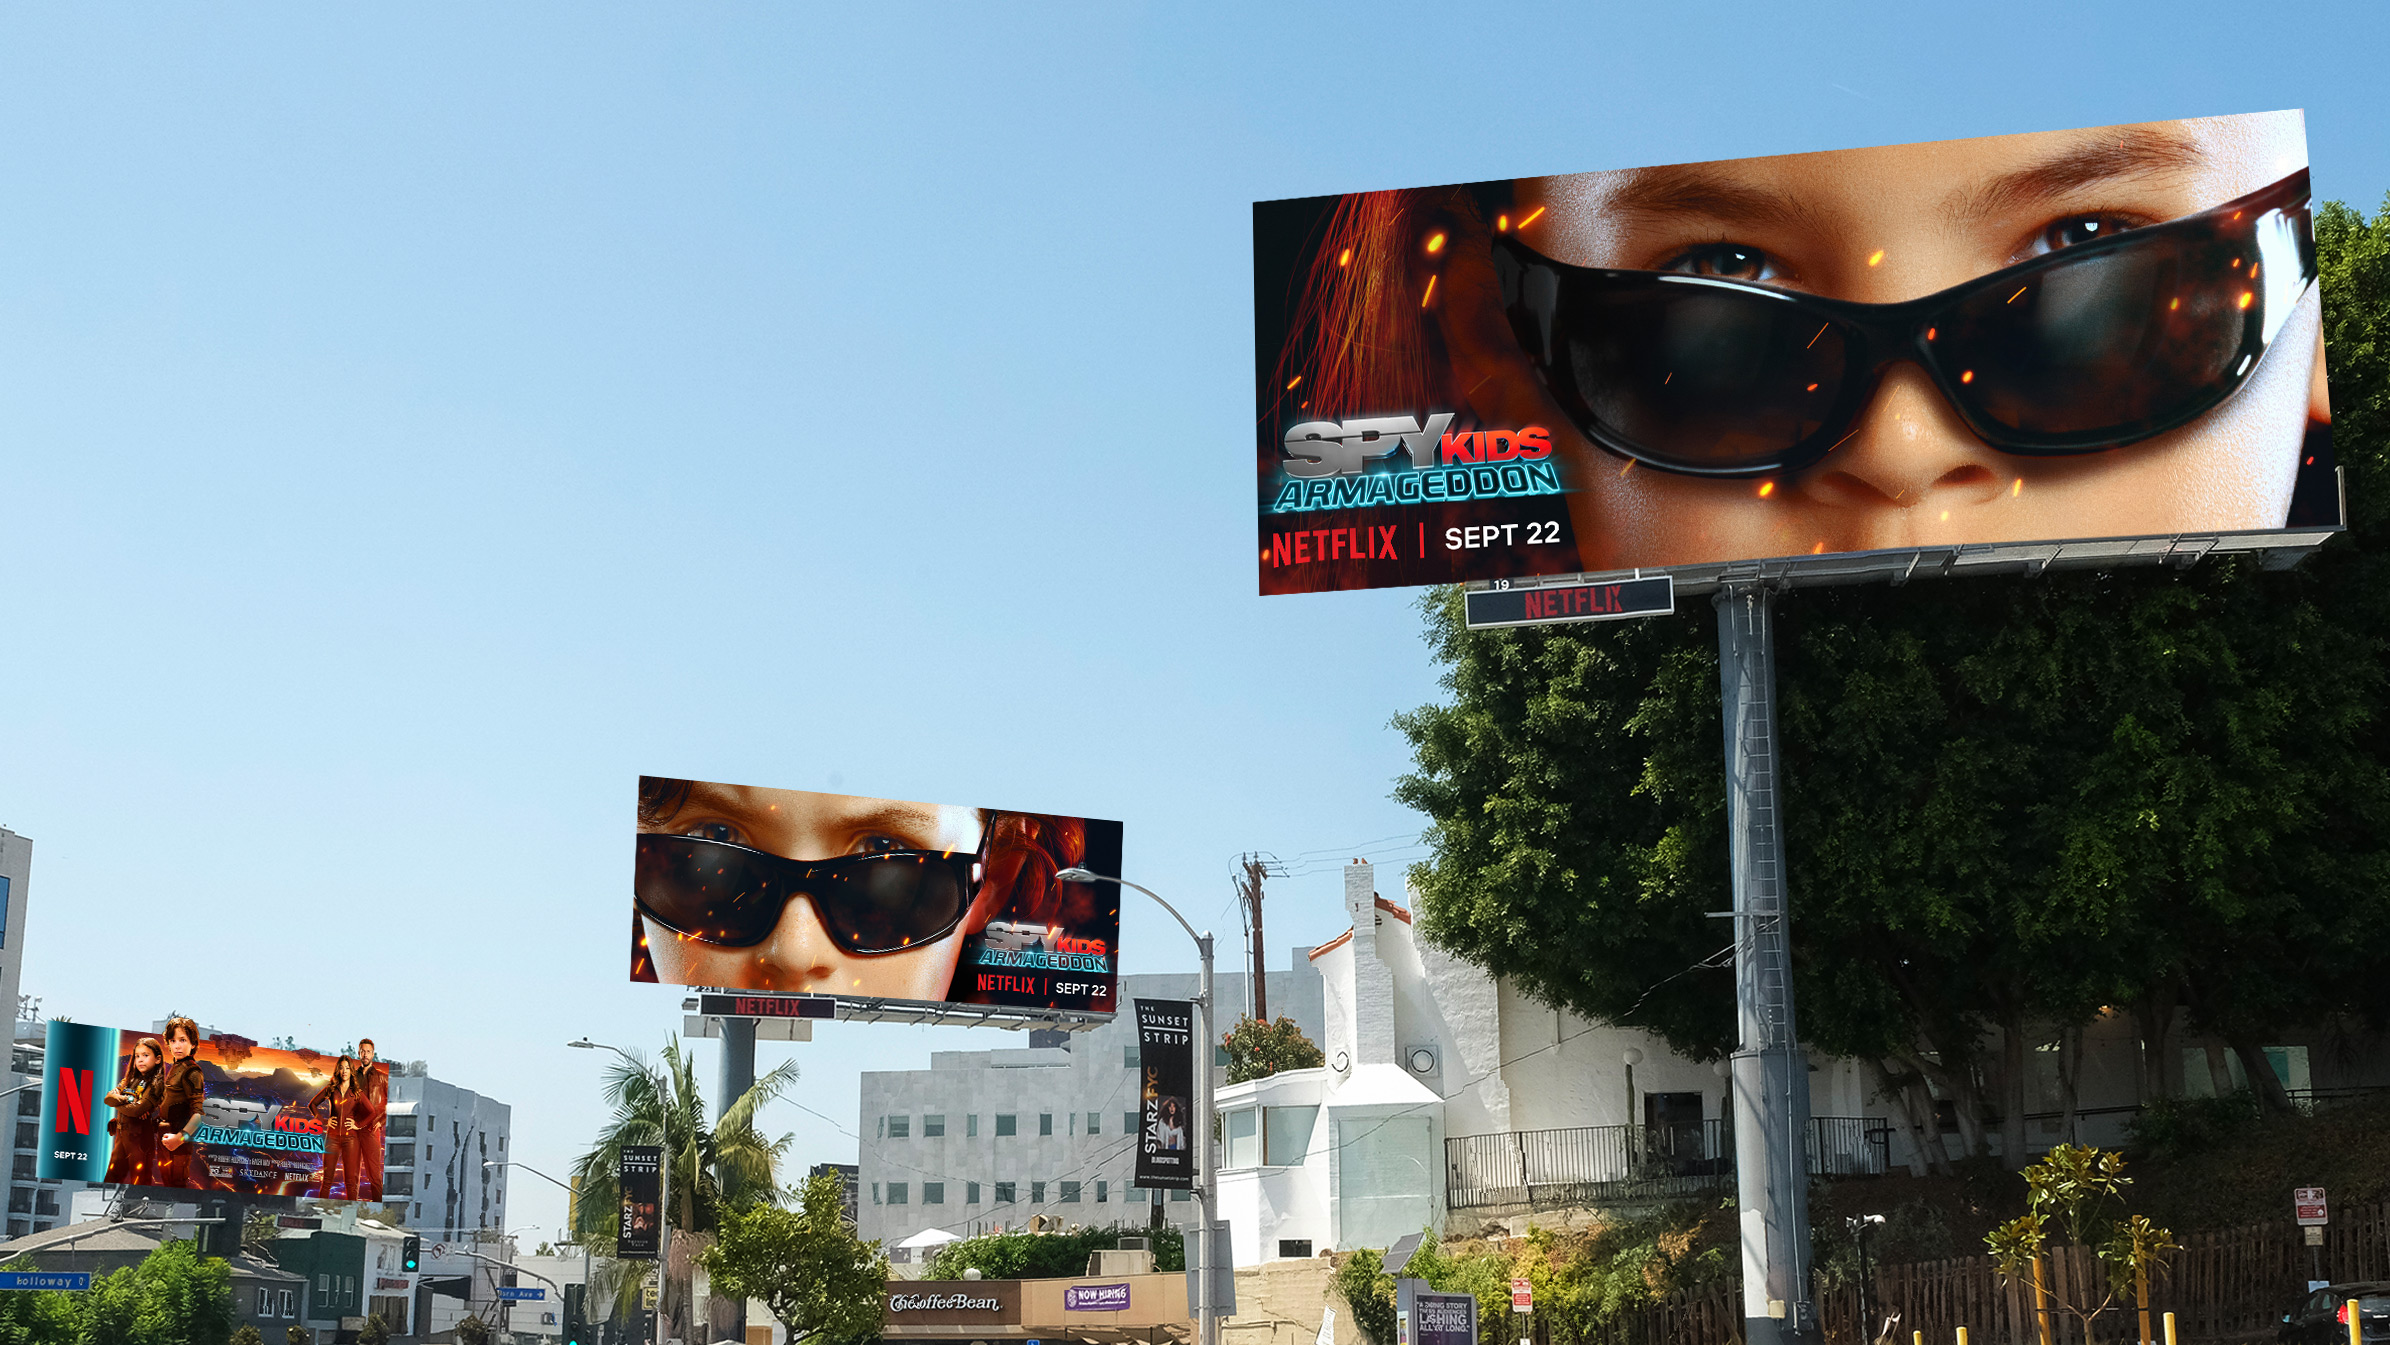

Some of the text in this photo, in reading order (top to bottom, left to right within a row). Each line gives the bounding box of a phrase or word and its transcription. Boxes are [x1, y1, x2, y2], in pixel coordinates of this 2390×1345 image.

[1282, 412, 1553, 479] SPY KIDS
[1273, 462, 1560, 512] ARMAGEDDON
[1272, 520, 1561, 568] NETFLIX SEPT 22
[1493, 579, 1510, 591] 19
[1524, 584, 1623, 620] NETFLIX
[984, 921, 1107, 956] SPY KIDS
[978, 948, 1109, 973] ARMAGEDDON
[977, 973, 1107, 997] NETFLIX SEPT 22
[735, 997, 800, 1017] NETFLIX
[1140, 1005, 1155, 1013] THE
[1141, 1014, 1189, 1028] SUNSET
[1143, 1031, 1189, 1046] STRIP
[55, 1066, 94, 1136] N
[1144, 1065, 1159, 1155] STARZ FYC
[200, 1097, 324, 1136] SPY KIDS
[193, 1125, 326, 1154] ARMAGEDDON
[53, 1150, 88, 1161] SEPT 22
[623, 1154, 658, 1162] SUNSET
[284, 1172, 309, 1182] NETFLIX
[623, 1165, 657, 1173] STRIP
[622, 1205, 634, 1239] STARZ
[949, 1293, 1000, 1312] Bean
[1078, 1289, 1098, 1300] NOW
